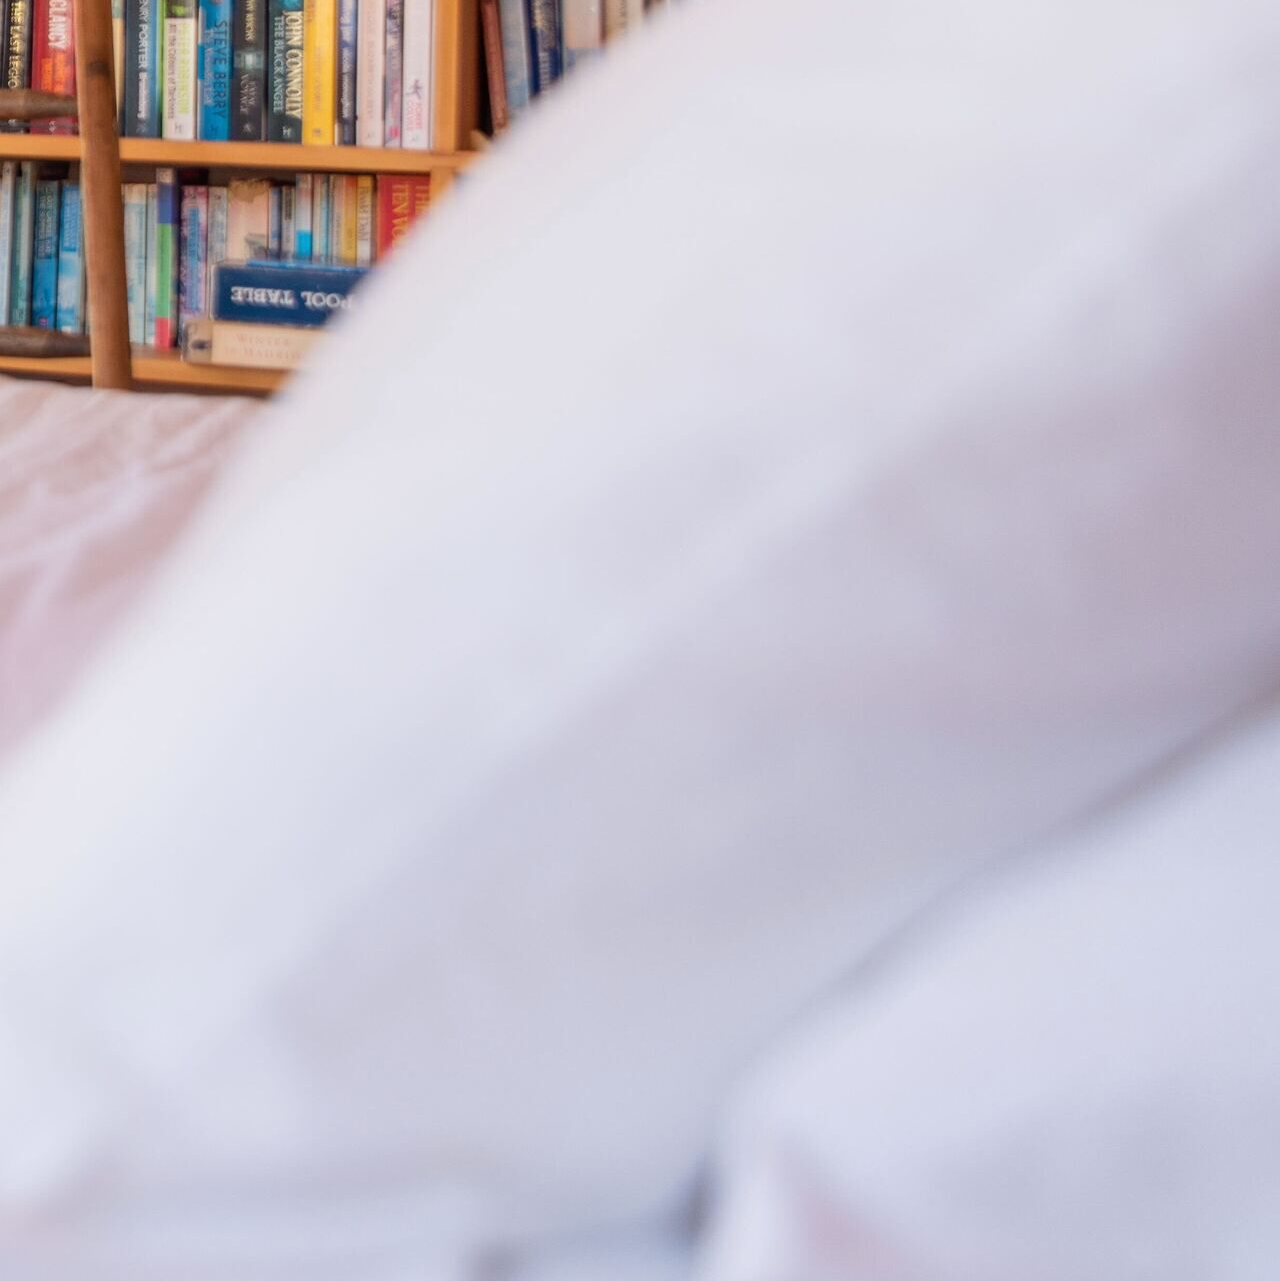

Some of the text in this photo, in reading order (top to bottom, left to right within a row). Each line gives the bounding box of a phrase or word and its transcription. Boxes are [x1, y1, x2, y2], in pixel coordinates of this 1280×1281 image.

[138, 23, 149, 70] PORTER
[272, 14, 285, 115] THE BLACK ANGEL
[283, 10, 304, 121] JOHN CONNOLLY
[213, 71, 228, 119] BERRY
[230, 286, 295, 307] TABLE
